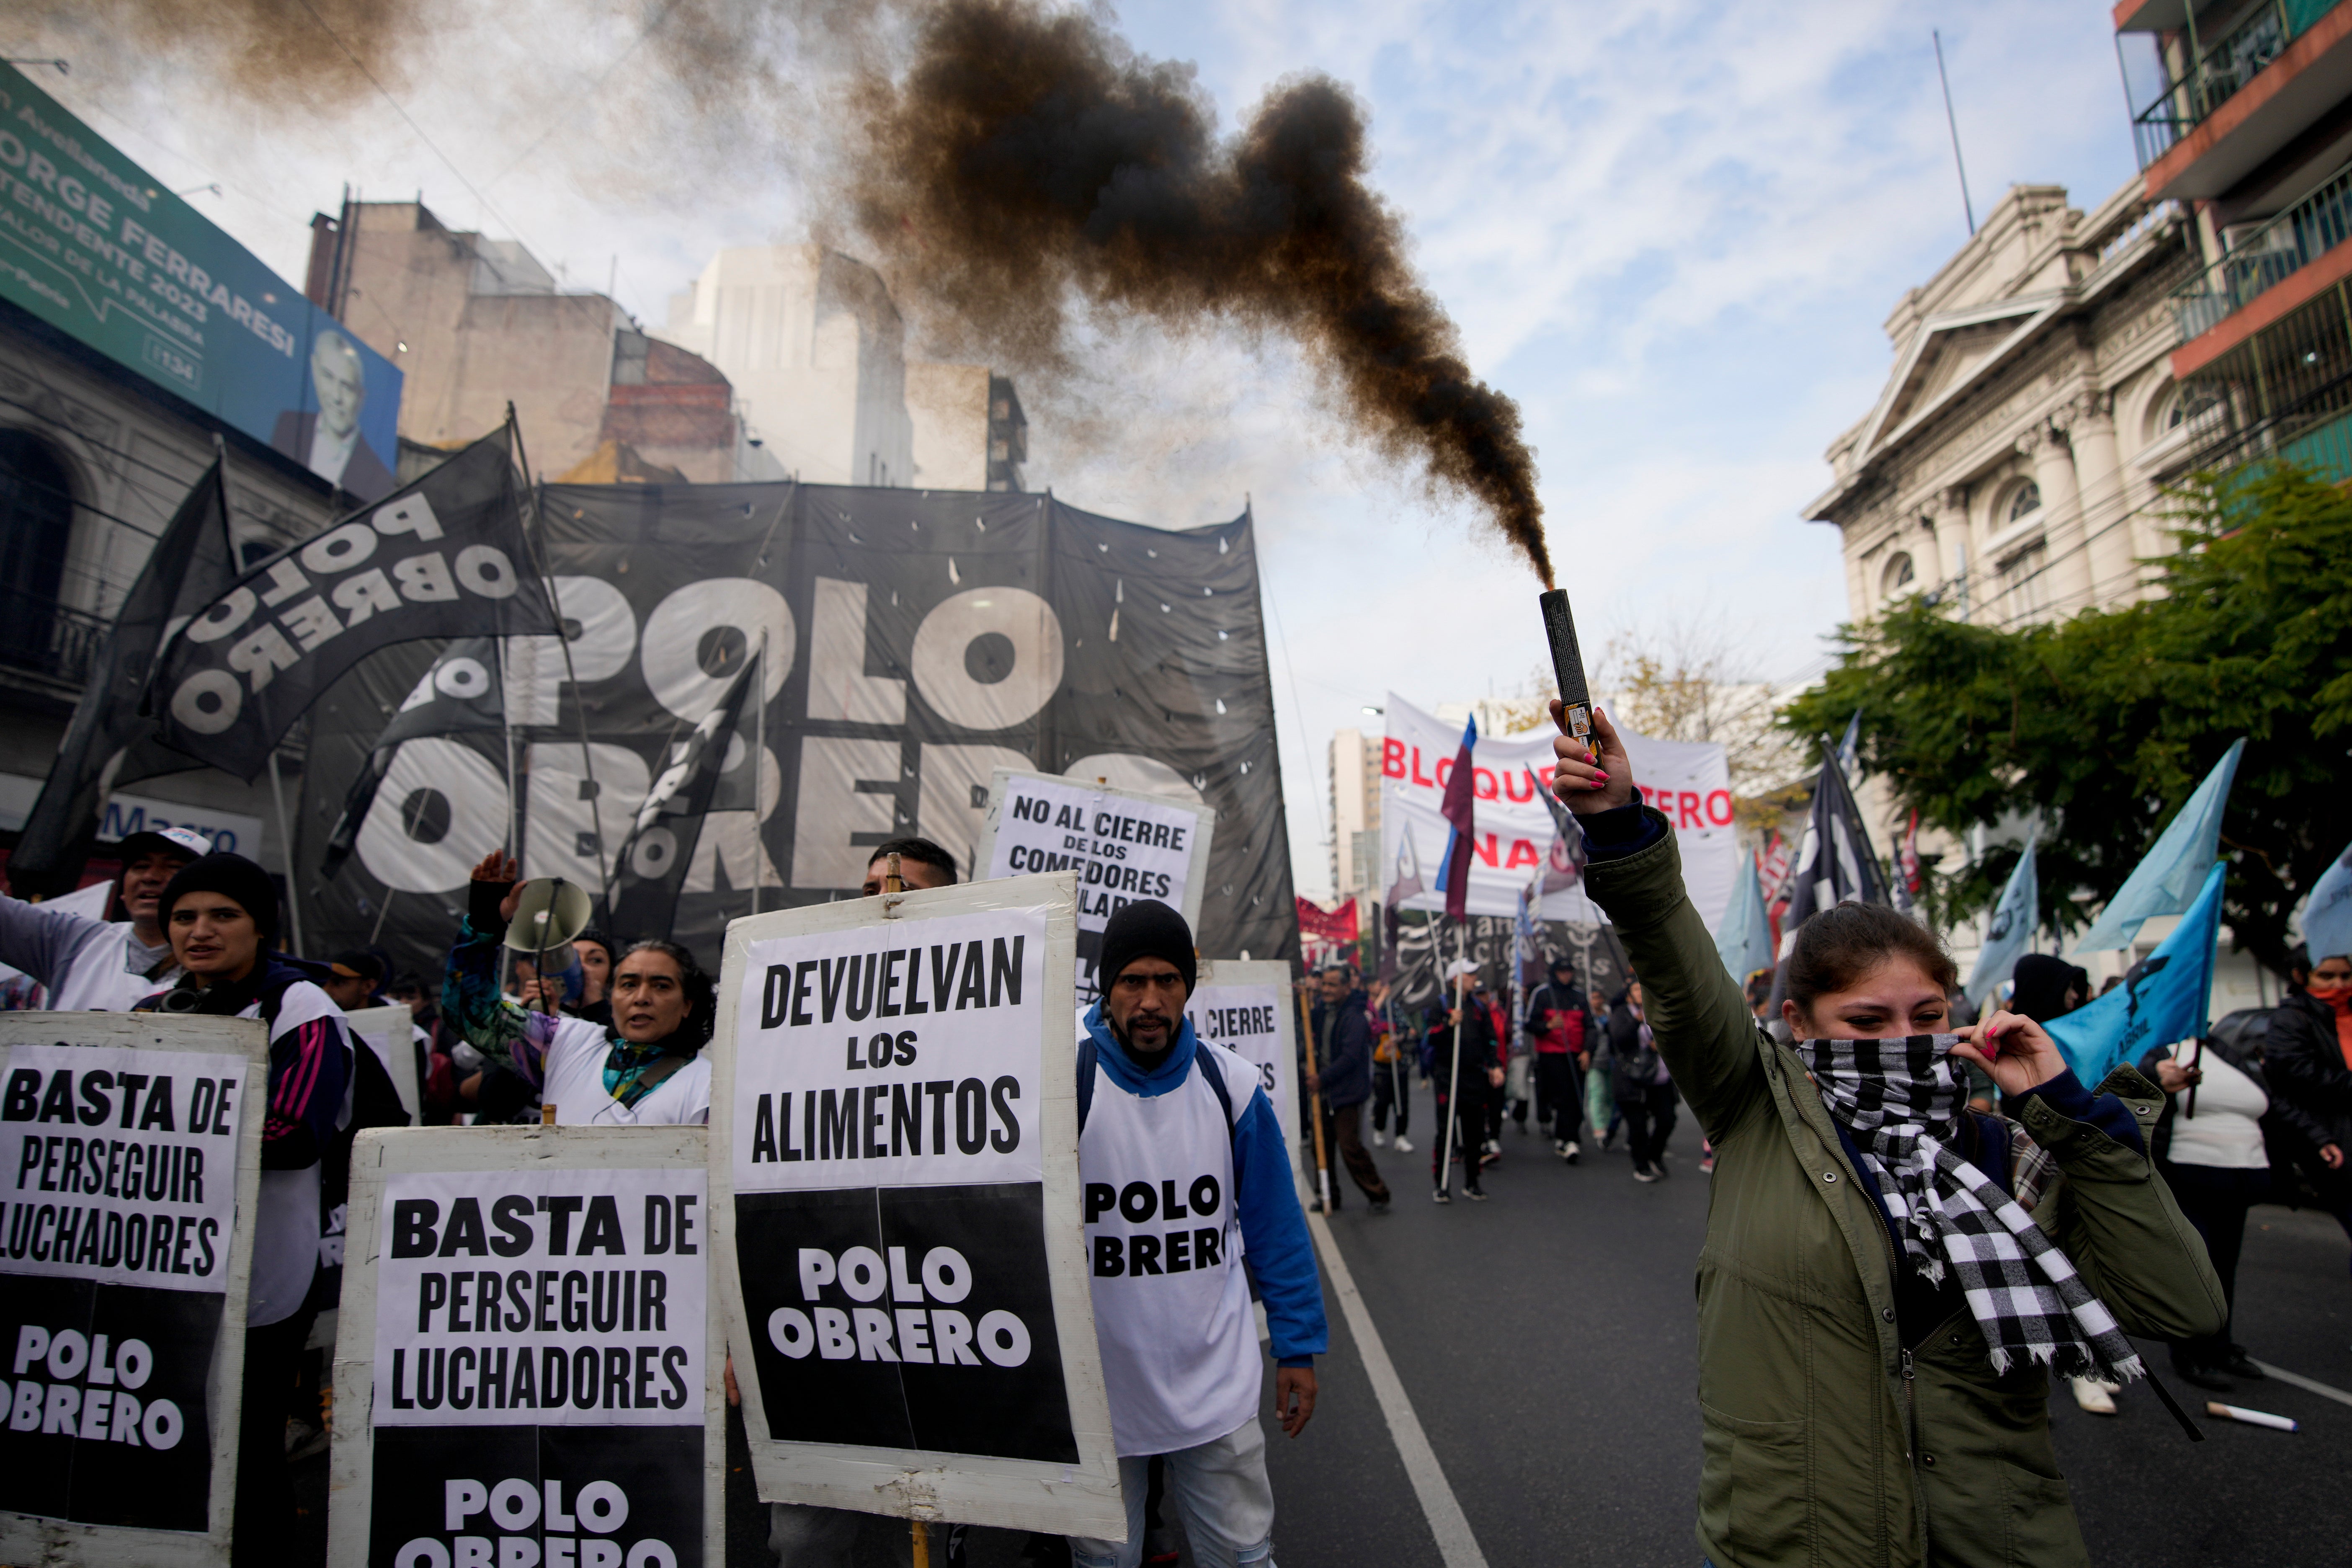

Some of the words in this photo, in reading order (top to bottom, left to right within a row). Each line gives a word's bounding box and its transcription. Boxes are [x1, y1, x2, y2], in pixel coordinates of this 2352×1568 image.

[0, 207, 60, 255] ALOR
[64, 248, 93, 276] DE
[95, 268, 121, 294] LA
[126, 287, 204, 347] PALABRA
[120, 216, 295, 358] FERRARESI
[150, 272, 208, 323] 2023
[506, 575, 1064, 731] POLO
[103, 803, 236, 853] Mro
[1013, 794, 1050, 824] NO
[1055, 804, 1086, 833] AL
[1093, 812, 1186, 851] CIERRE
[1064, 835, 1086, 853] DE
[1092, 840, 1127, 860] LOS
[1009, 845, 1171, 898] COMEDORES
[760, 935, 1024, 1030] DEVUELVAN
[846, 1030, 917, 1070] LOS
[1206, 1006, 1275, 1039] CIERRE
[2, 1068, 176, 1132] BASTA
[189, 1077, 237, 1135] DE
[752, 1075, 1020, 1163] ALIMENTOS
[17, 1135, 204, 1204] PERSEGUIR
[1085, 1174, 1220, 1224] POLO
[391, 1194, 627, 1259] BASTA
[644, 1195, 698, 1255] DE
[1086, 1220, 1227, 1278] BRER
[418, 1269, 668, 1333] PERSEGUIR
[797, 1245, 973, 1303] POLO
[14, 1324, 153, 1390] POLO
[767, 1306, 1032, 1368] OBRERO
[392, 1345, 688, 1410] LUCHADORES
[445, 1478, 629, 1533] POLO
